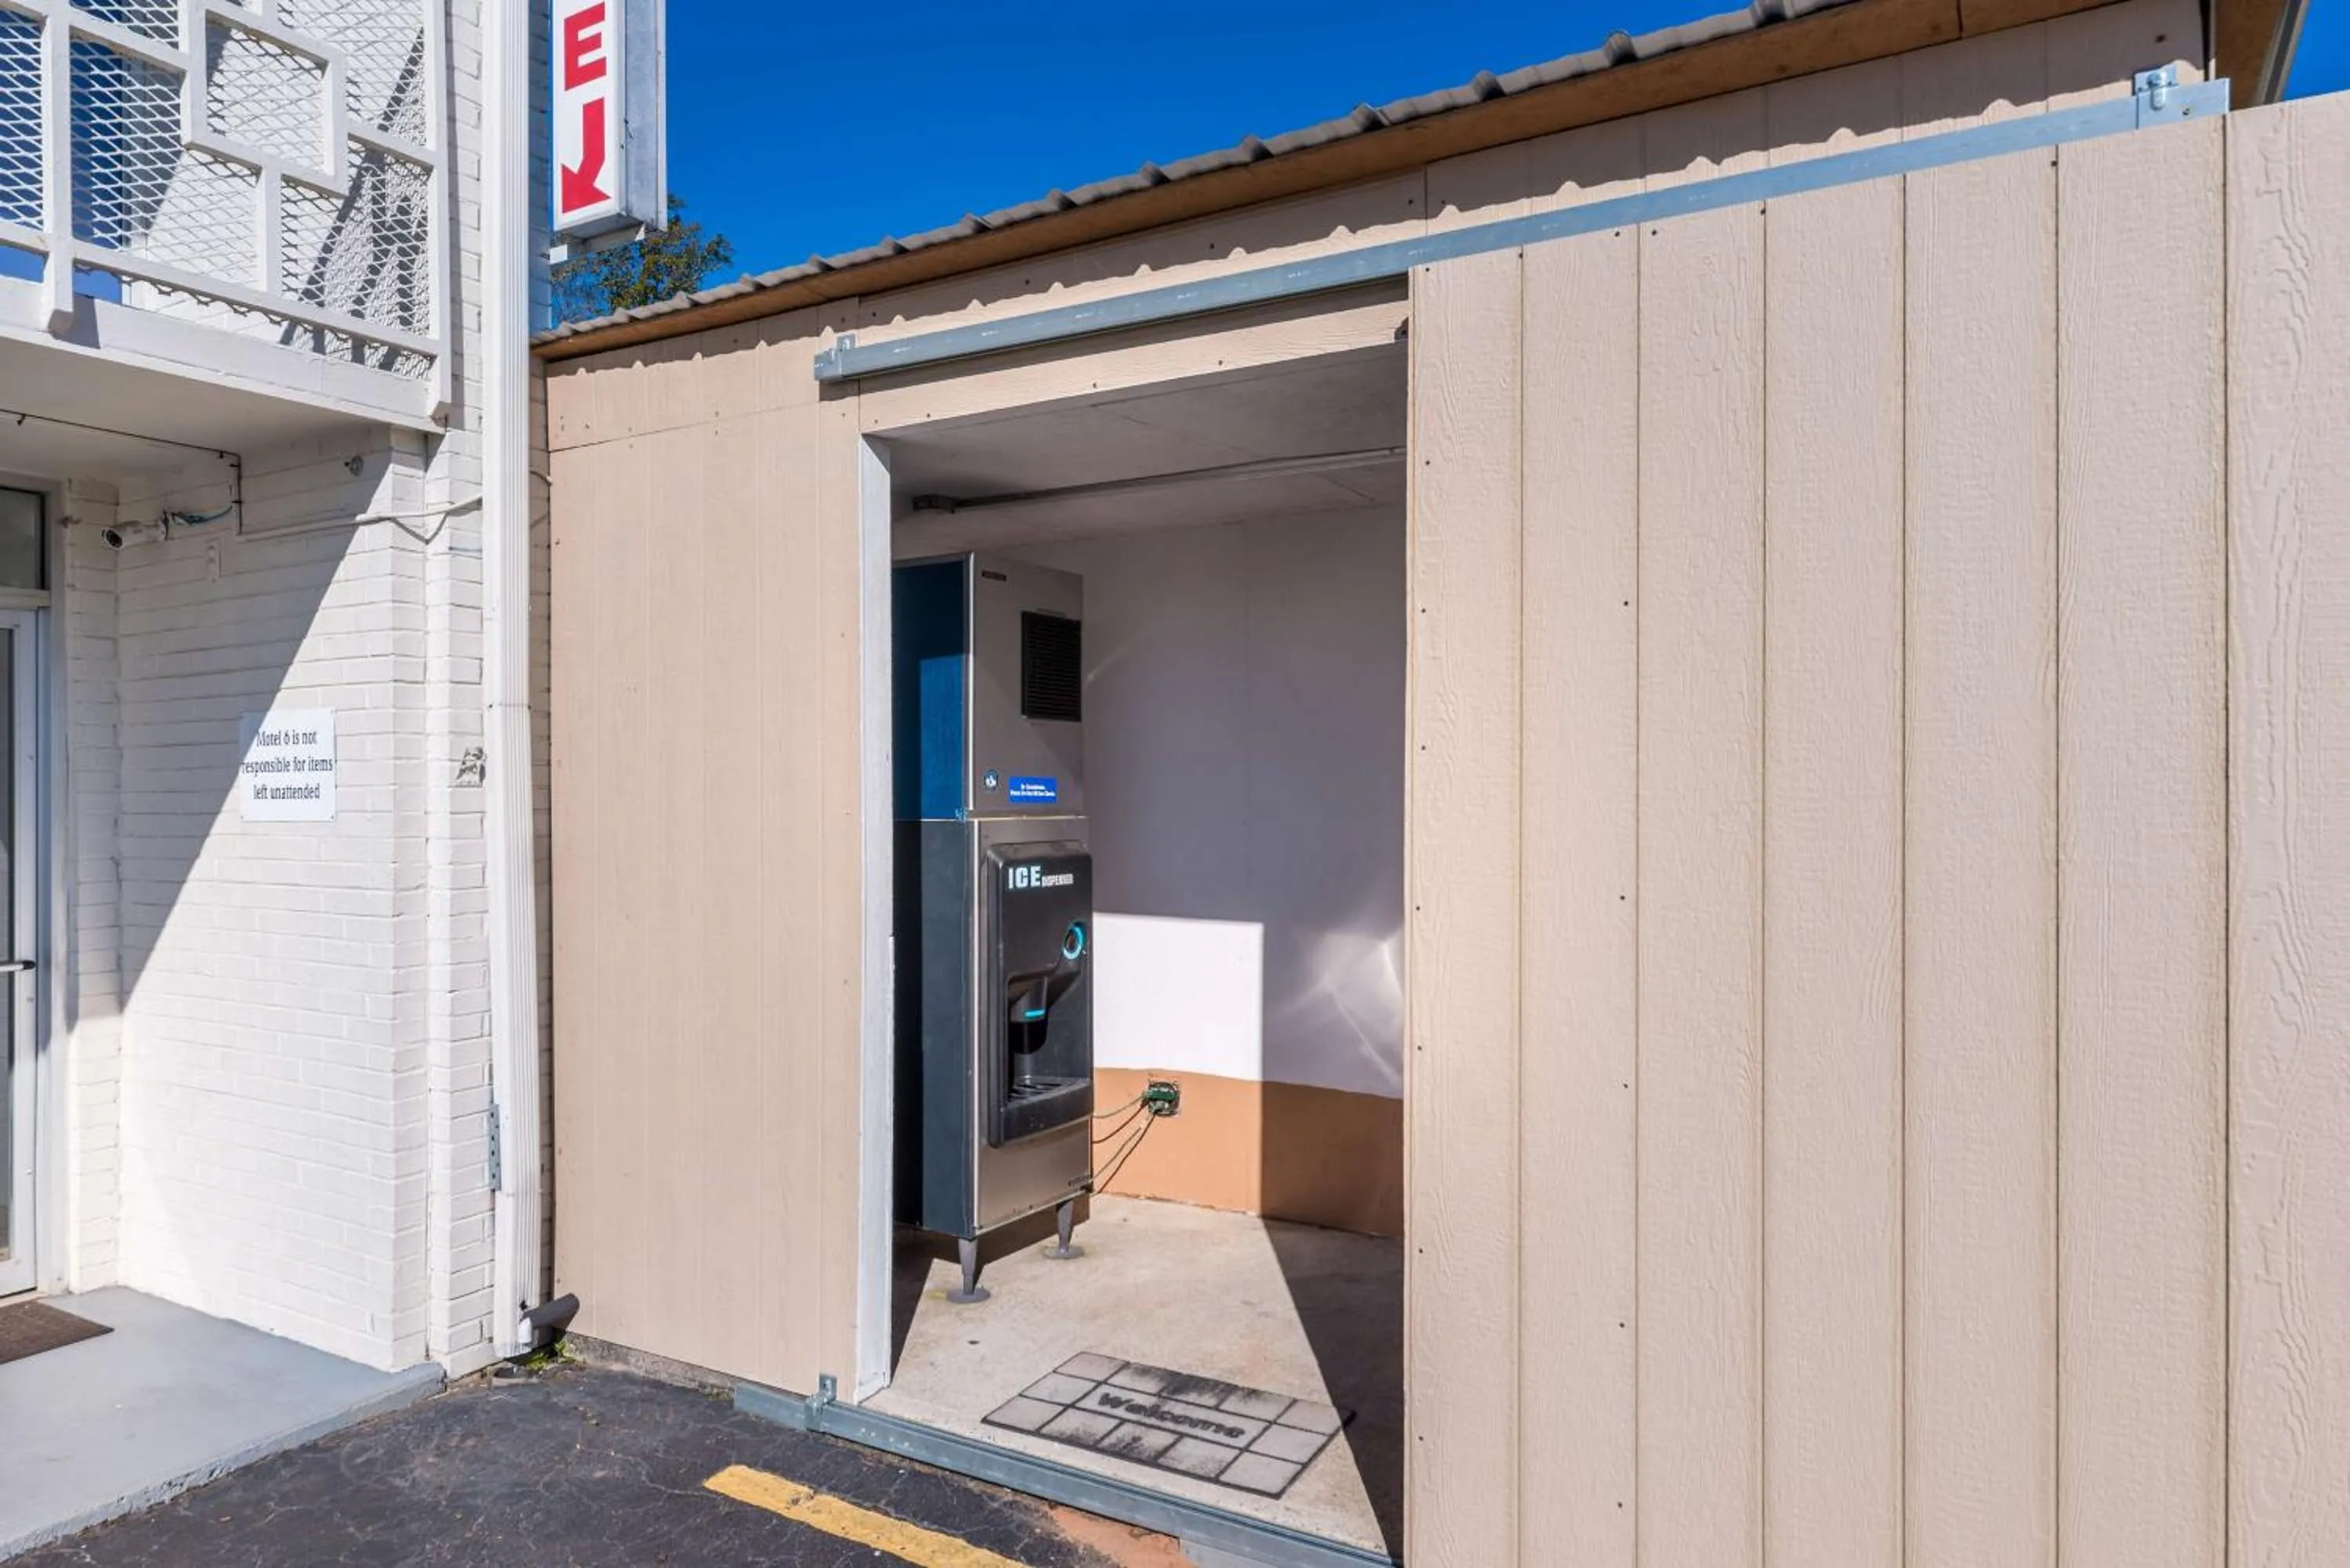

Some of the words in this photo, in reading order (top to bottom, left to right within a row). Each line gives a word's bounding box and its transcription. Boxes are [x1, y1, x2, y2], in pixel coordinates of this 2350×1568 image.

[564, 2, 606, 92] E
[257, 730, 281, 746] Motel
[284, 730, 291, 745] 6
[292, 729, 299, 745] is
[302, 731, 317, 745] not
[241, 757, 291, 777] responsible
[293, 757, 306, 771] for
[308, 756, 333, 771] items
[253, 784, 268, 799] left
[270, 782, 320, 799] unattended
[1008, 865, 1041, 889] ICE
[1097, 1390, 1246, 1440] Welcome
